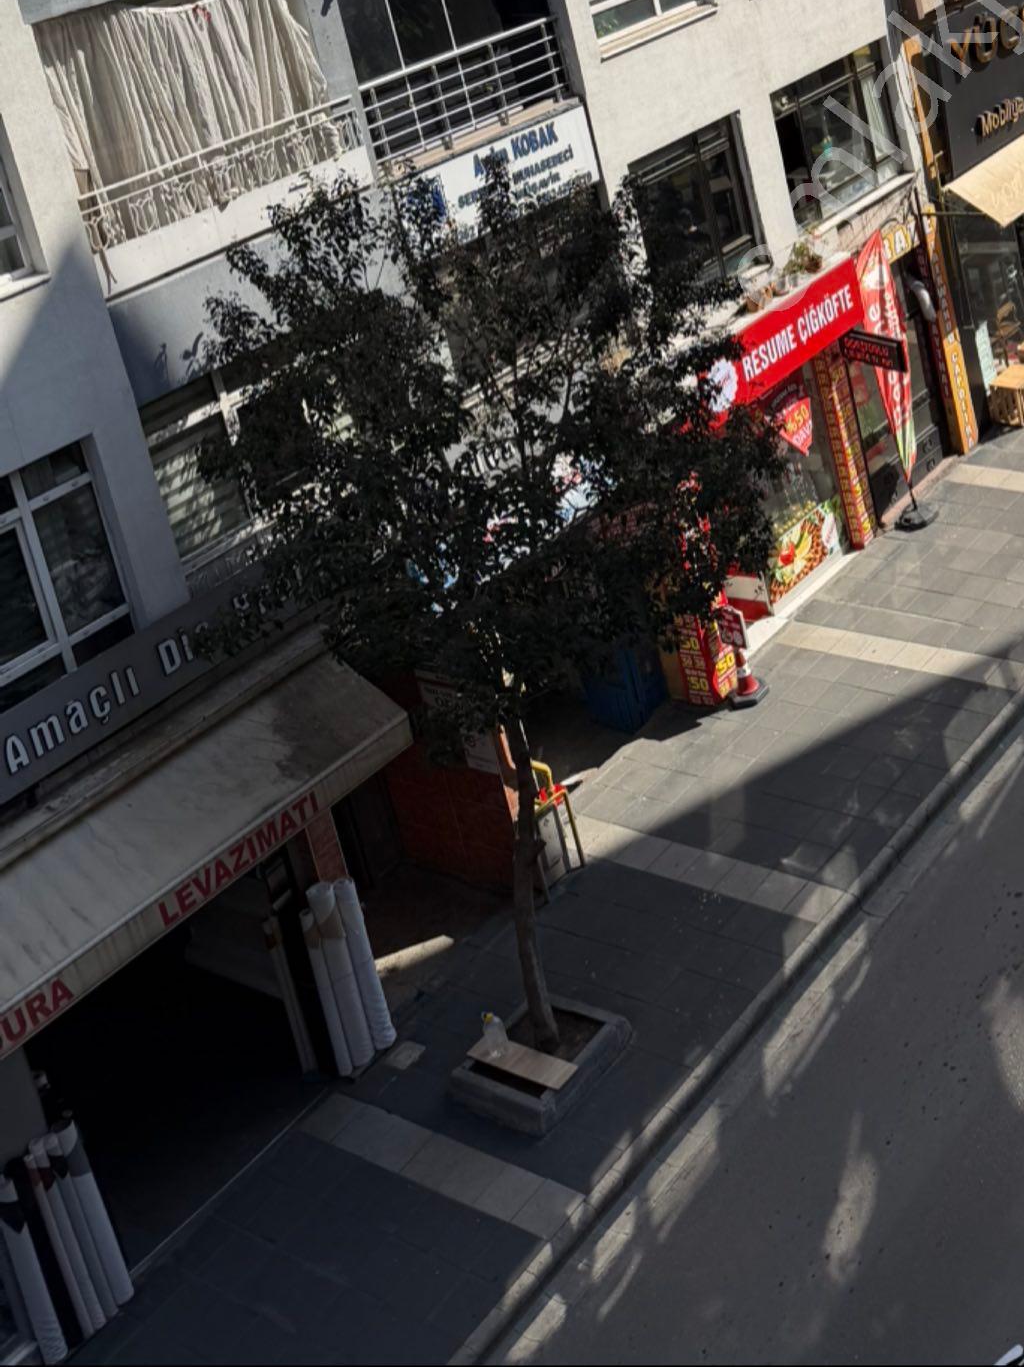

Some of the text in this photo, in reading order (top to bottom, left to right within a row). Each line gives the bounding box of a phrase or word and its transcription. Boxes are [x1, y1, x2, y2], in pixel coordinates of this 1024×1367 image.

[511, 121, 558, 161] KOBAK
[741, 324, 797, 382] RESUME
[4, 665, 140, 775] Amaçlı
[0, 791, 321, 1058] URA LEVAZIMATI
